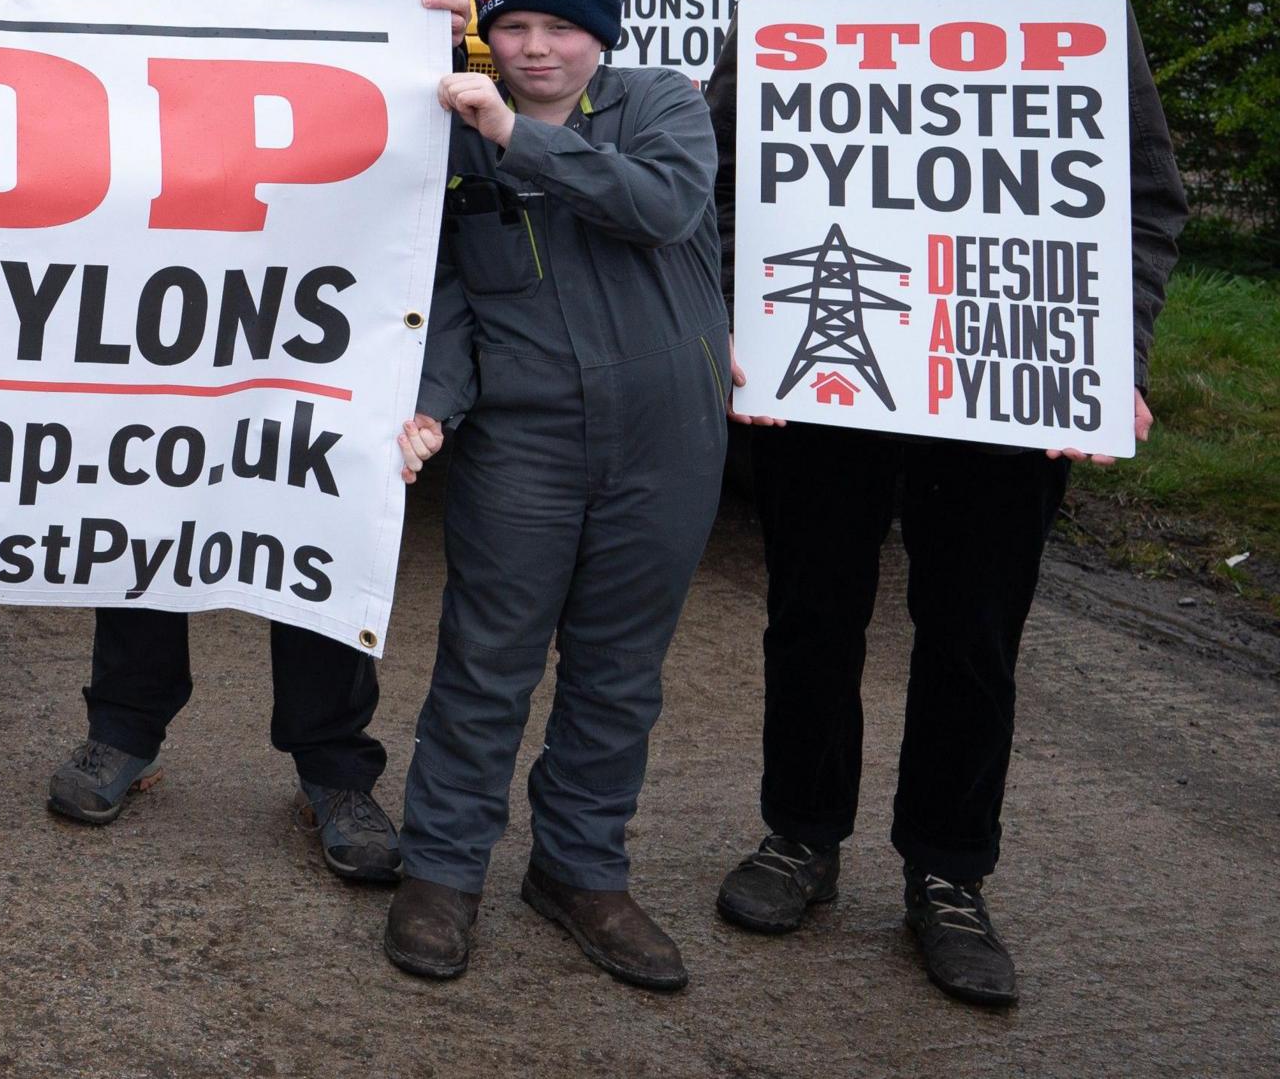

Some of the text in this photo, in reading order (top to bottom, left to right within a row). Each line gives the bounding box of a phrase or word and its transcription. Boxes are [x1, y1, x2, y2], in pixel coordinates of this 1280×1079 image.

[755, 21, 1108, 73] STOP
[760, 82, 1105, 140] MONSTER
[760, 142, 1106, 219] PYLONS
[927, 233, 1100, 307] DEESIDE
[927, 299, 1100, 366] AGAINST
[927, 355, 1102, 433] PYLONS
